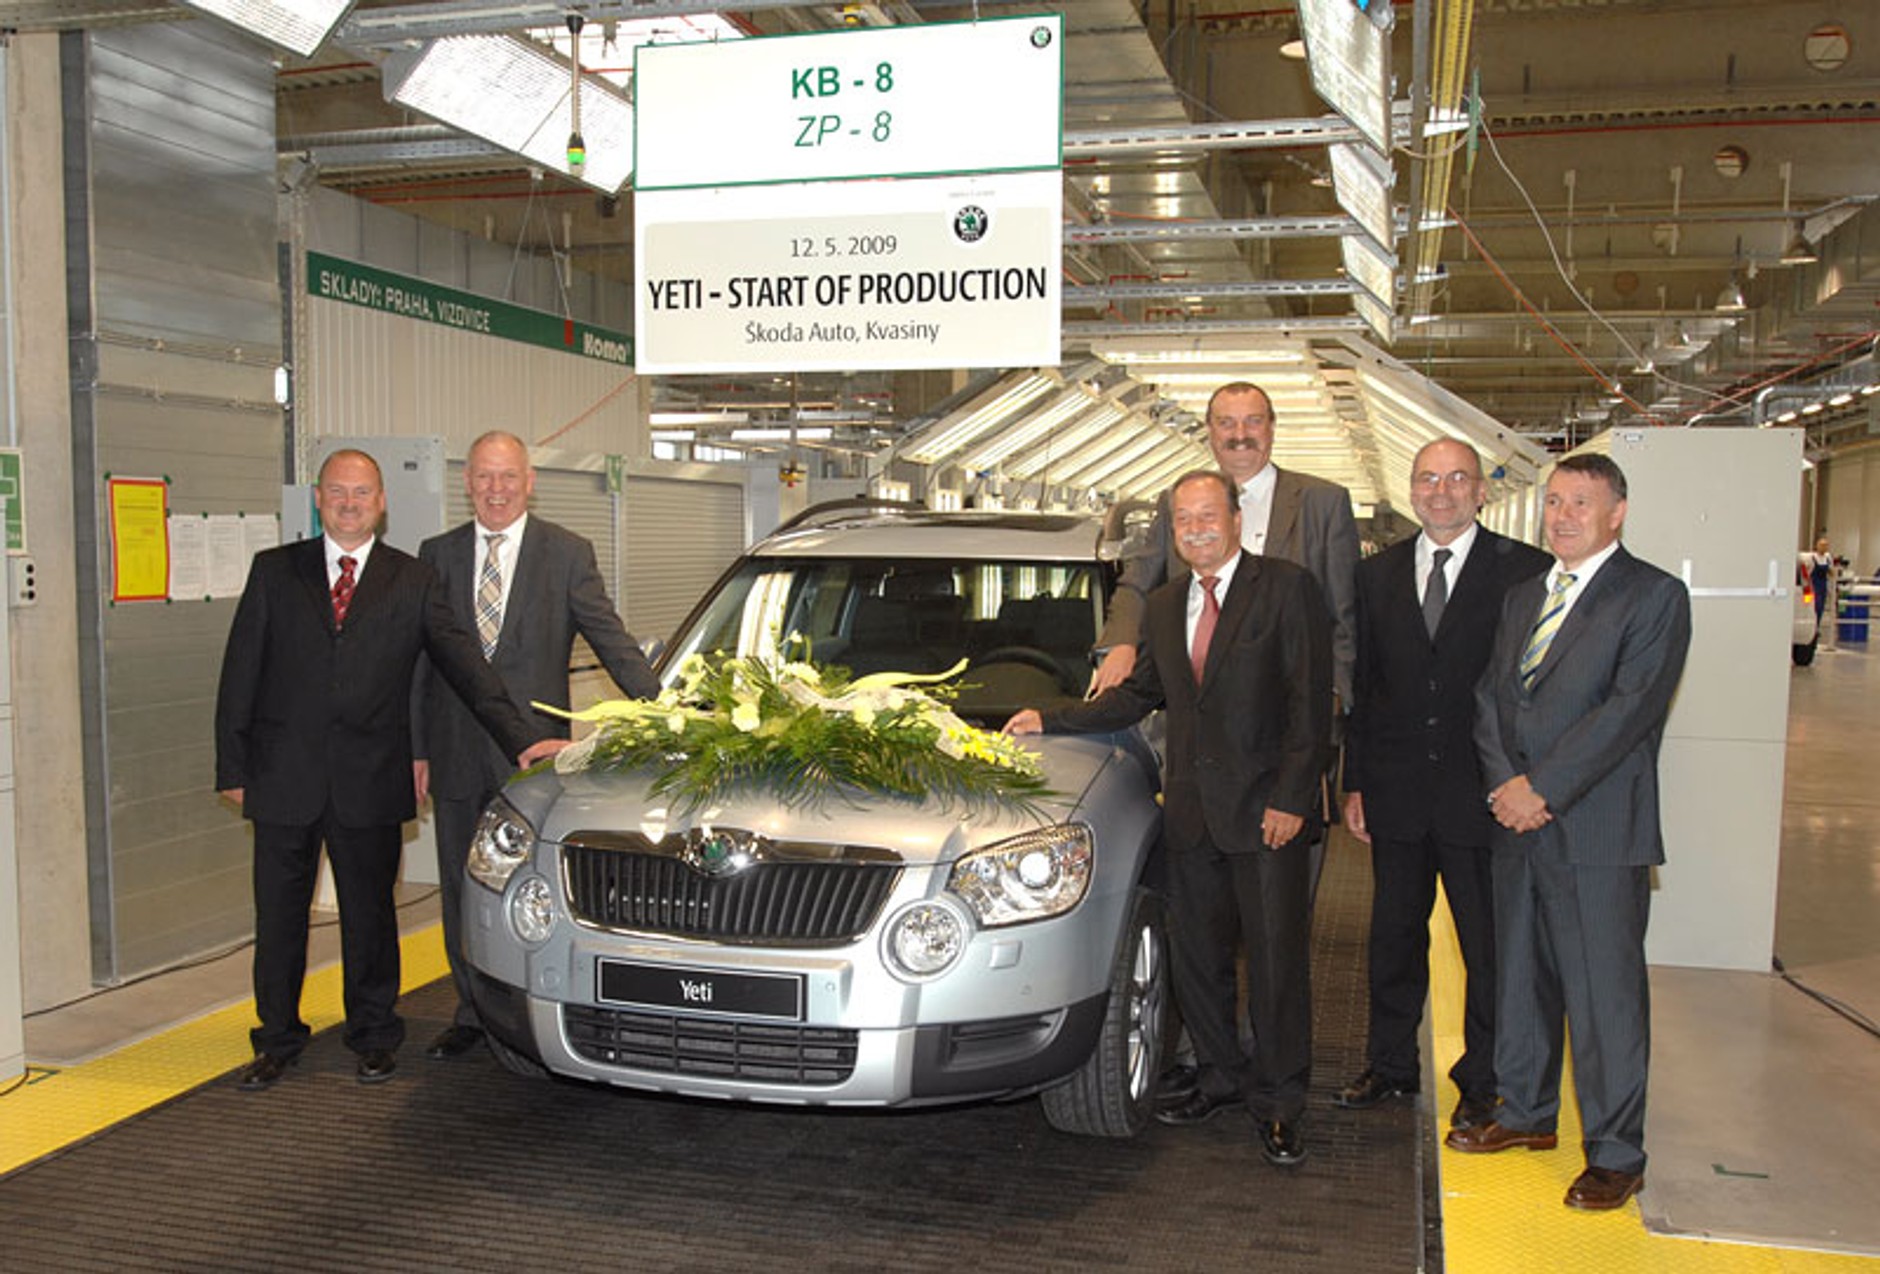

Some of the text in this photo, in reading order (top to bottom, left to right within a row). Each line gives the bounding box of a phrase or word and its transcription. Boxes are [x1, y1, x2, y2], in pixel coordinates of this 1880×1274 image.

[791, 66, 841, 100] KB
[874, 61, 895, 93] 8
[793, 114, 842, 148] ZP
[871, 110, 893, 143] 8
[791, 235, 898, 258] 12. 5. 2009
[319, 270, 382, 306] SKLADY:
[648, 279, 703, 310] YETI
[728, 275, 810, 309] START
[815, 274, 853, 307] OF
[859, 267, 1047, 305] PRODUCTION
[745, 320, 940, 344] Škoda Auto, Kvasiny
[679, 979, 713, 1003] Yeti
